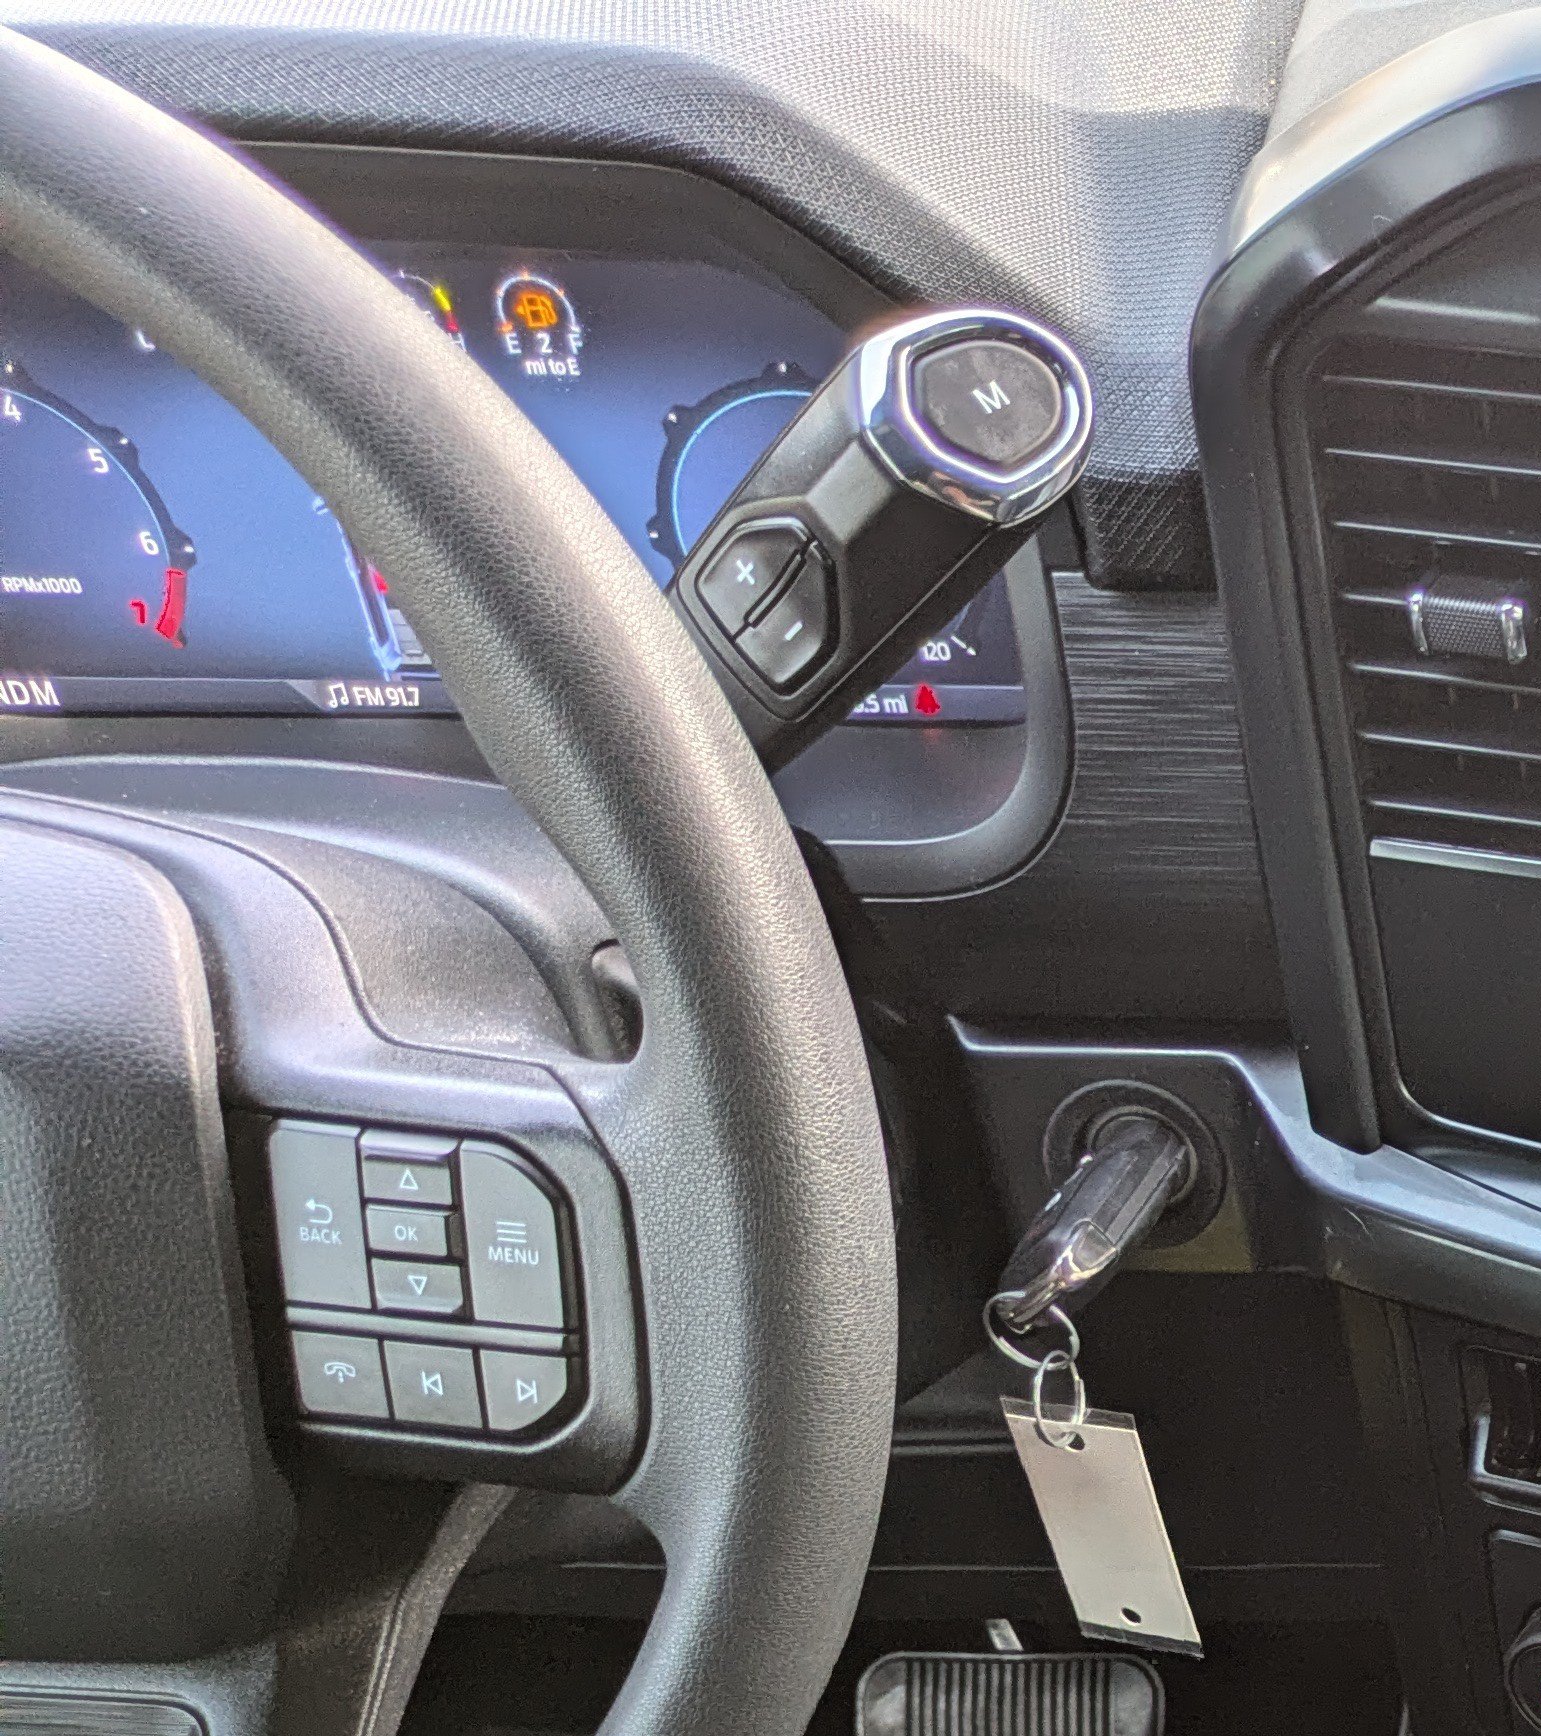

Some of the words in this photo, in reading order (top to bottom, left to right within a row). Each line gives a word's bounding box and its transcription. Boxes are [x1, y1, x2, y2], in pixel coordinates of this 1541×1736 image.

[504, 332, 522, 355] E
[536, 331, 553, 354] 2
[525, 359, 547, 376] mi
[549, 359, 567, 376] to
[567, 357, 581, 376] E
[972, 379, 1011, 414] M
[2, 394, 22, 422] 4
[86, 447, 109, 474] 5
[138, 530, 159, 556] 6
[1, 576, 83, 594] RPMx1000
[129, 599, 147, 625] 7
[352, 686, 386, 706] FM
[386, 686, 420, 707] 91.7
[882, 694, 909, 714] mi
[299, 1225, 343, 1245] BACK
[394, 1224, 419, 1242] OK
[487, 1245, 539, 1266] MENU
